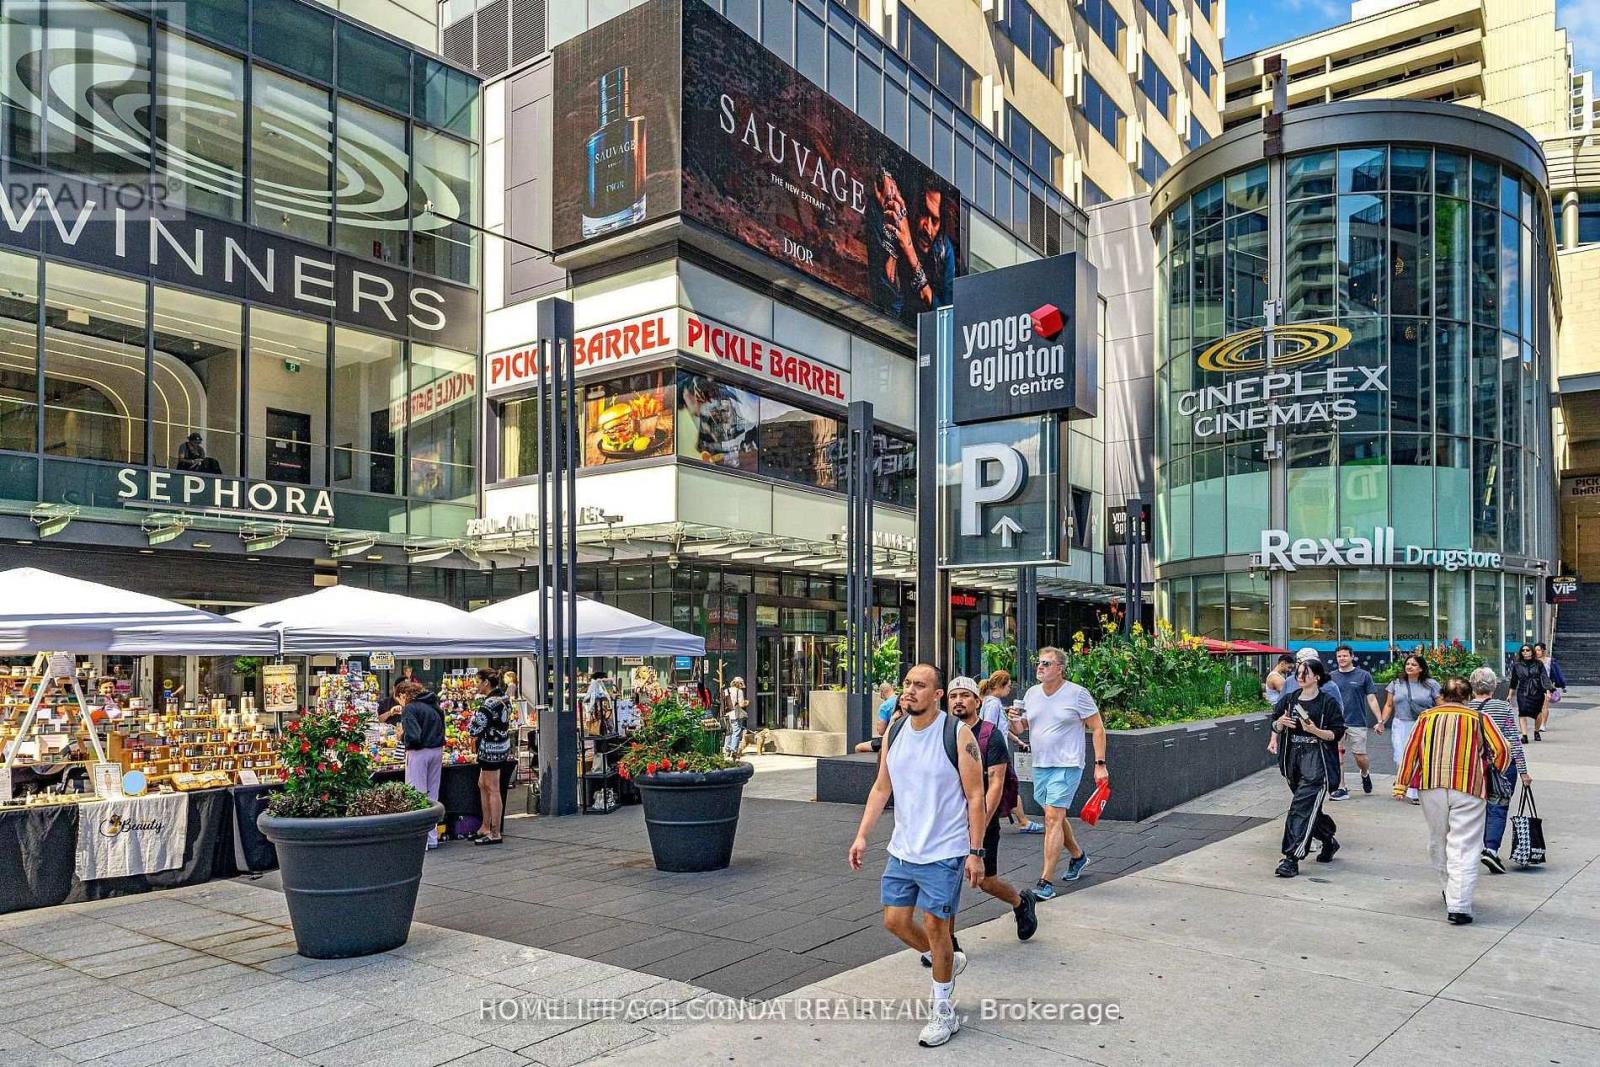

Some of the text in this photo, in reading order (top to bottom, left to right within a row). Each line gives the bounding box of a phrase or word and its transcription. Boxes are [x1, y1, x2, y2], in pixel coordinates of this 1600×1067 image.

[594, 139, 637, 164] SAUVAGE
[719, 93, 867, 215] SAUVAGE
[771, 173, 825, 211] THE NEW EXTRAIT
[0, 180, 446, 332] WINNERS
[783, 236, 815, 267] DIOR
[491, 317, 671, 385] PICK BARREL
[687, 317, 845, 400] PICKLE BARREL
[962, 312, 1032, 359] yonge
[969, 343, 1064, 391] eglinton
[1010, 377, 1065, 397] centre
[1177, 365, 1389, 416] CINEPLEX
[1194, 399, 1358, 437] CINEMAS
[117, 468, 336, 517] SEPHORA
[960, 443, 1027, 536] P
[1261, 527, 1501, 571] Rexall Drugstore
[1552, 586, 1577, 594] VIP
[121, 818, 164, 834] Beauty
